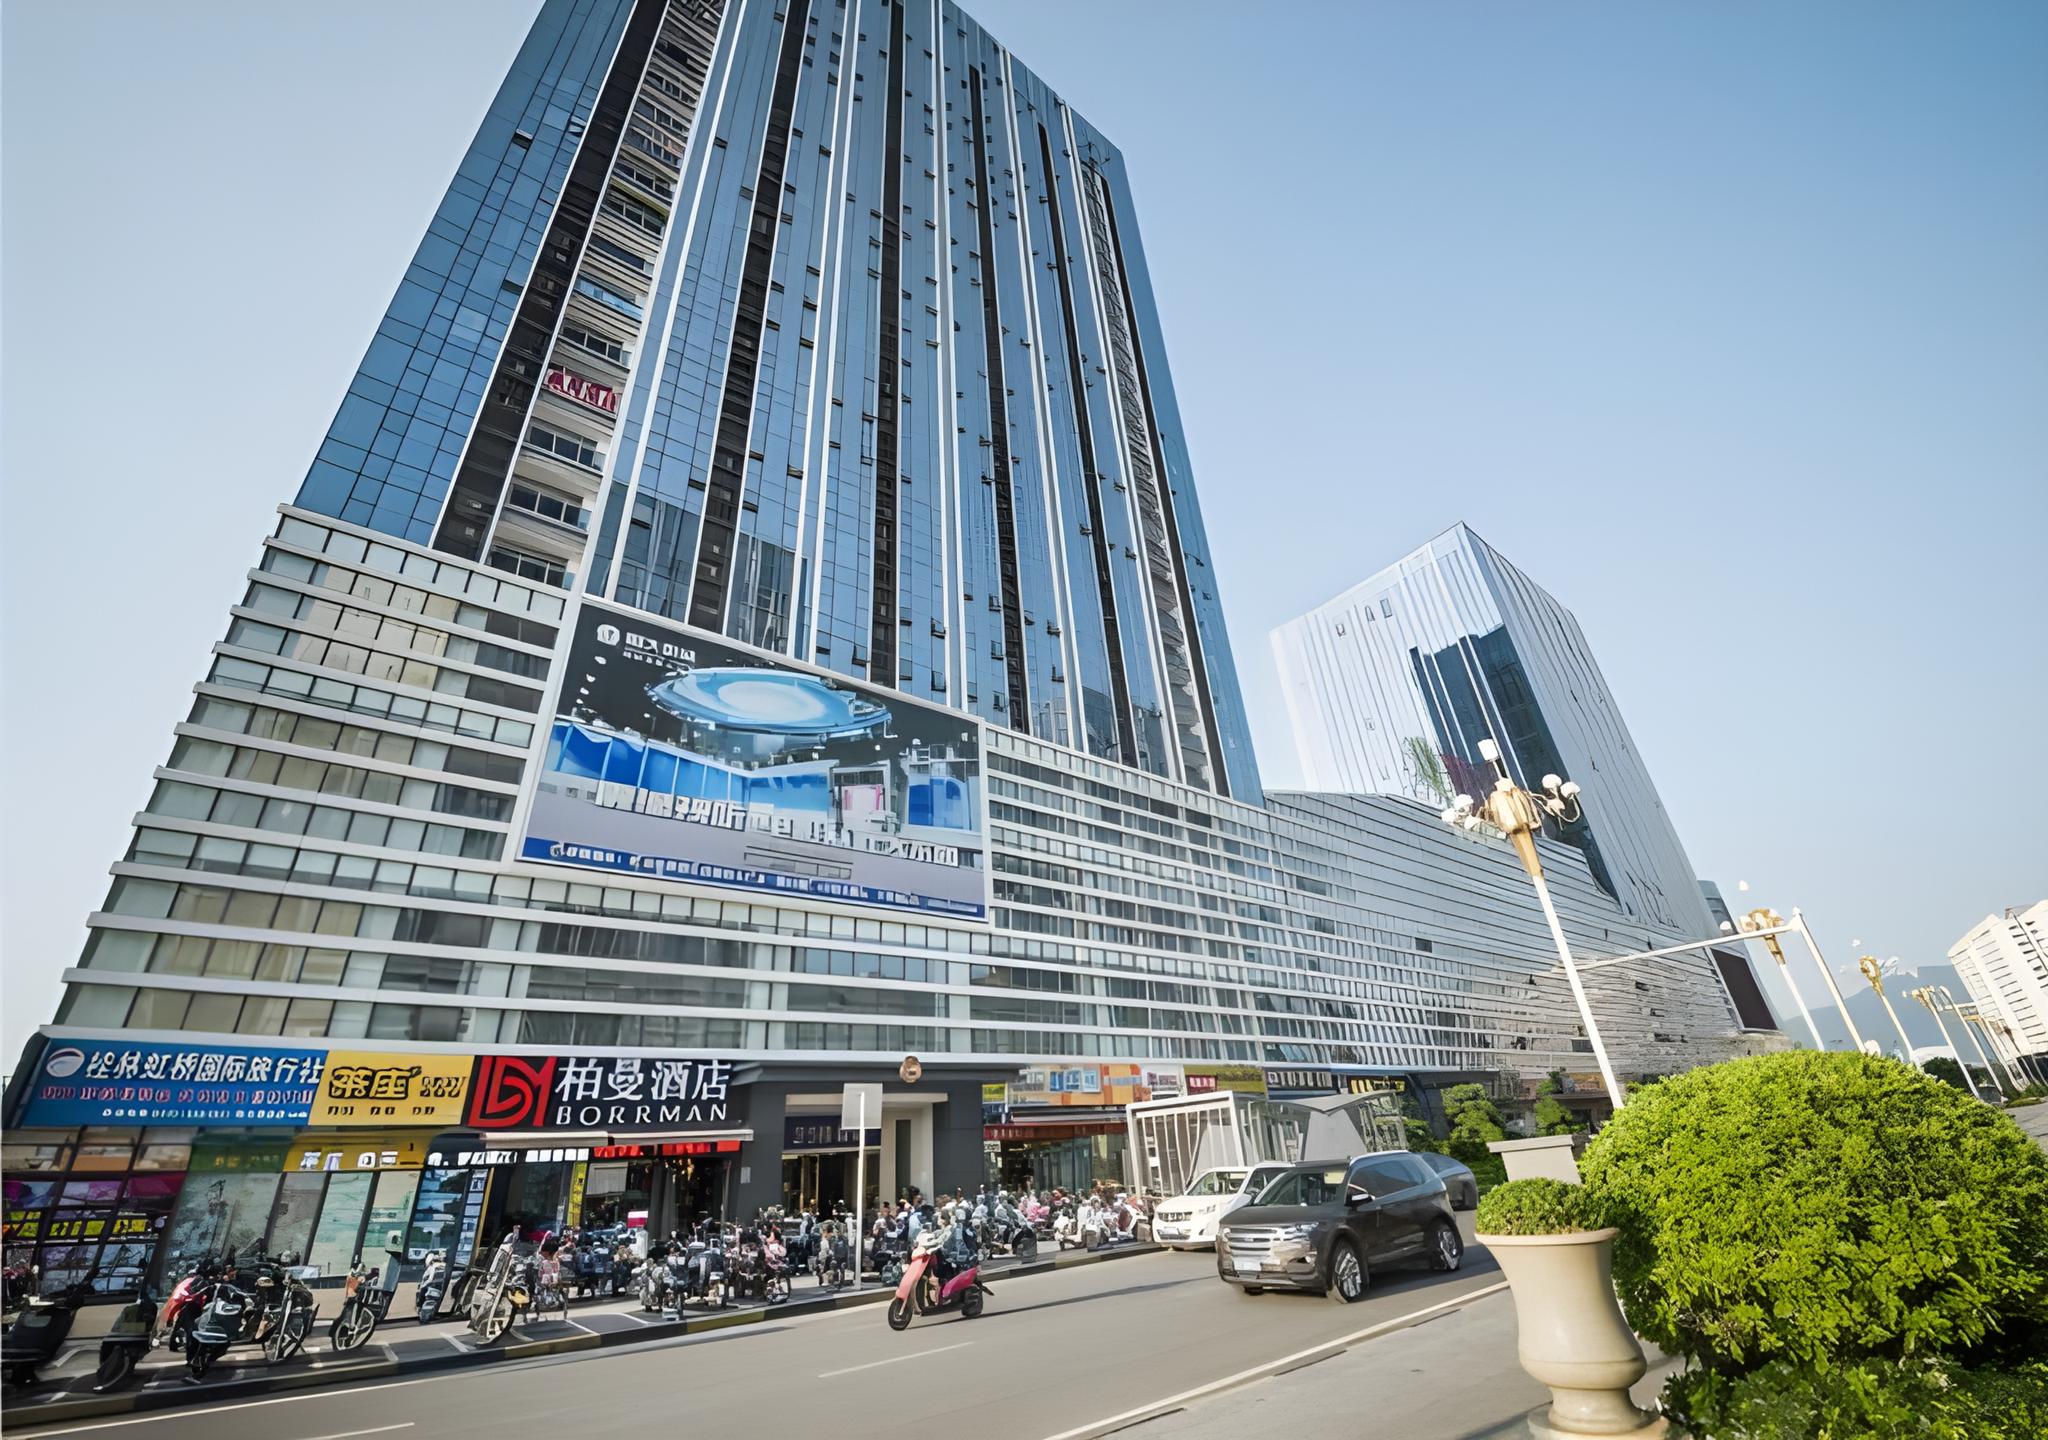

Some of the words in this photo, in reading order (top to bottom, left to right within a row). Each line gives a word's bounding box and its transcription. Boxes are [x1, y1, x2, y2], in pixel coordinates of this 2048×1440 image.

[555, 1057, 731, 1101] 柏曼酒店
[556, 1103, 727, 1125] BORRMAN
